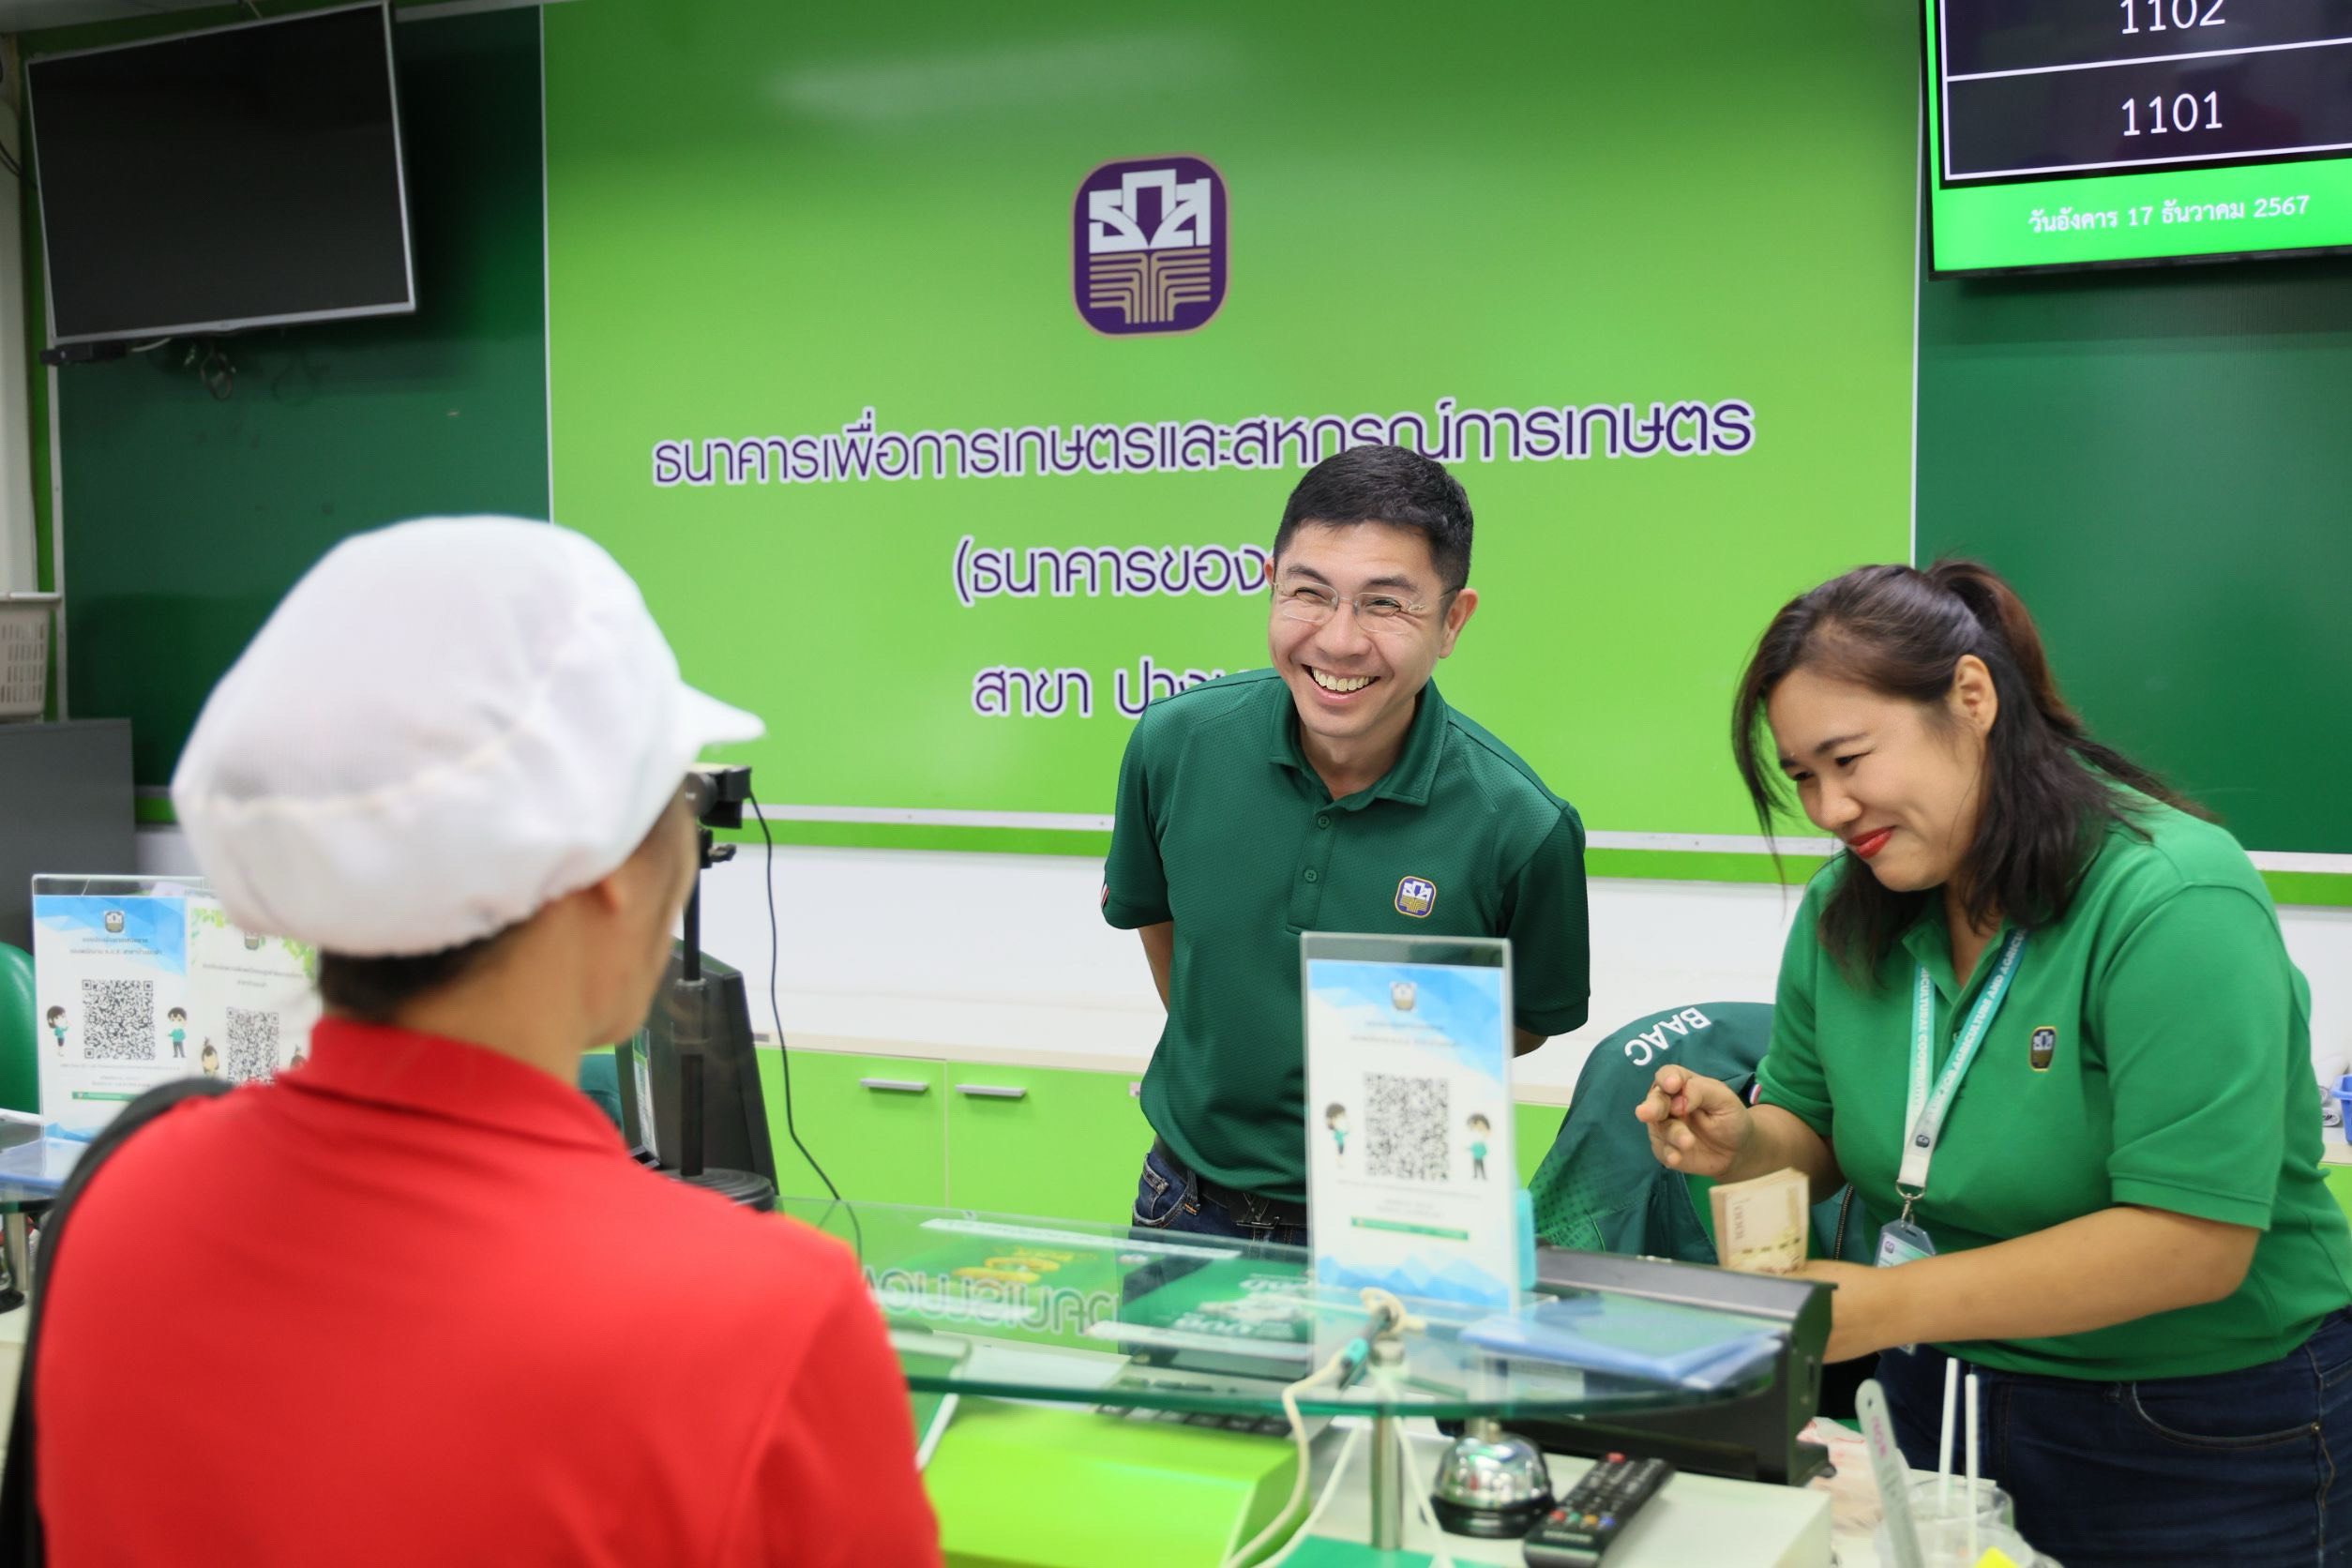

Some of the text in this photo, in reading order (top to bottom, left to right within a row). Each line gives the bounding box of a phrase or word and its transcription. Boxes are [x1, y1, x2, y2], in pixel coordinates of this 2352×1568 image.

[2120, 0, 2226, 35] 1102
[2120, 91, 2224, 137] 1101
[2028, 194, 2311, 234] วันอังคาร 17 ธันวาคม 2567
[653, 398, 1755, 486] ธนาคารเพื่อการเกษตรและสหกรณ์การเกษตร
[972, 663, 1093, 718] สาขา
[1986, 974, 2005, 1000] AND
[1624, 1007, 1711, 1066] BAAC
